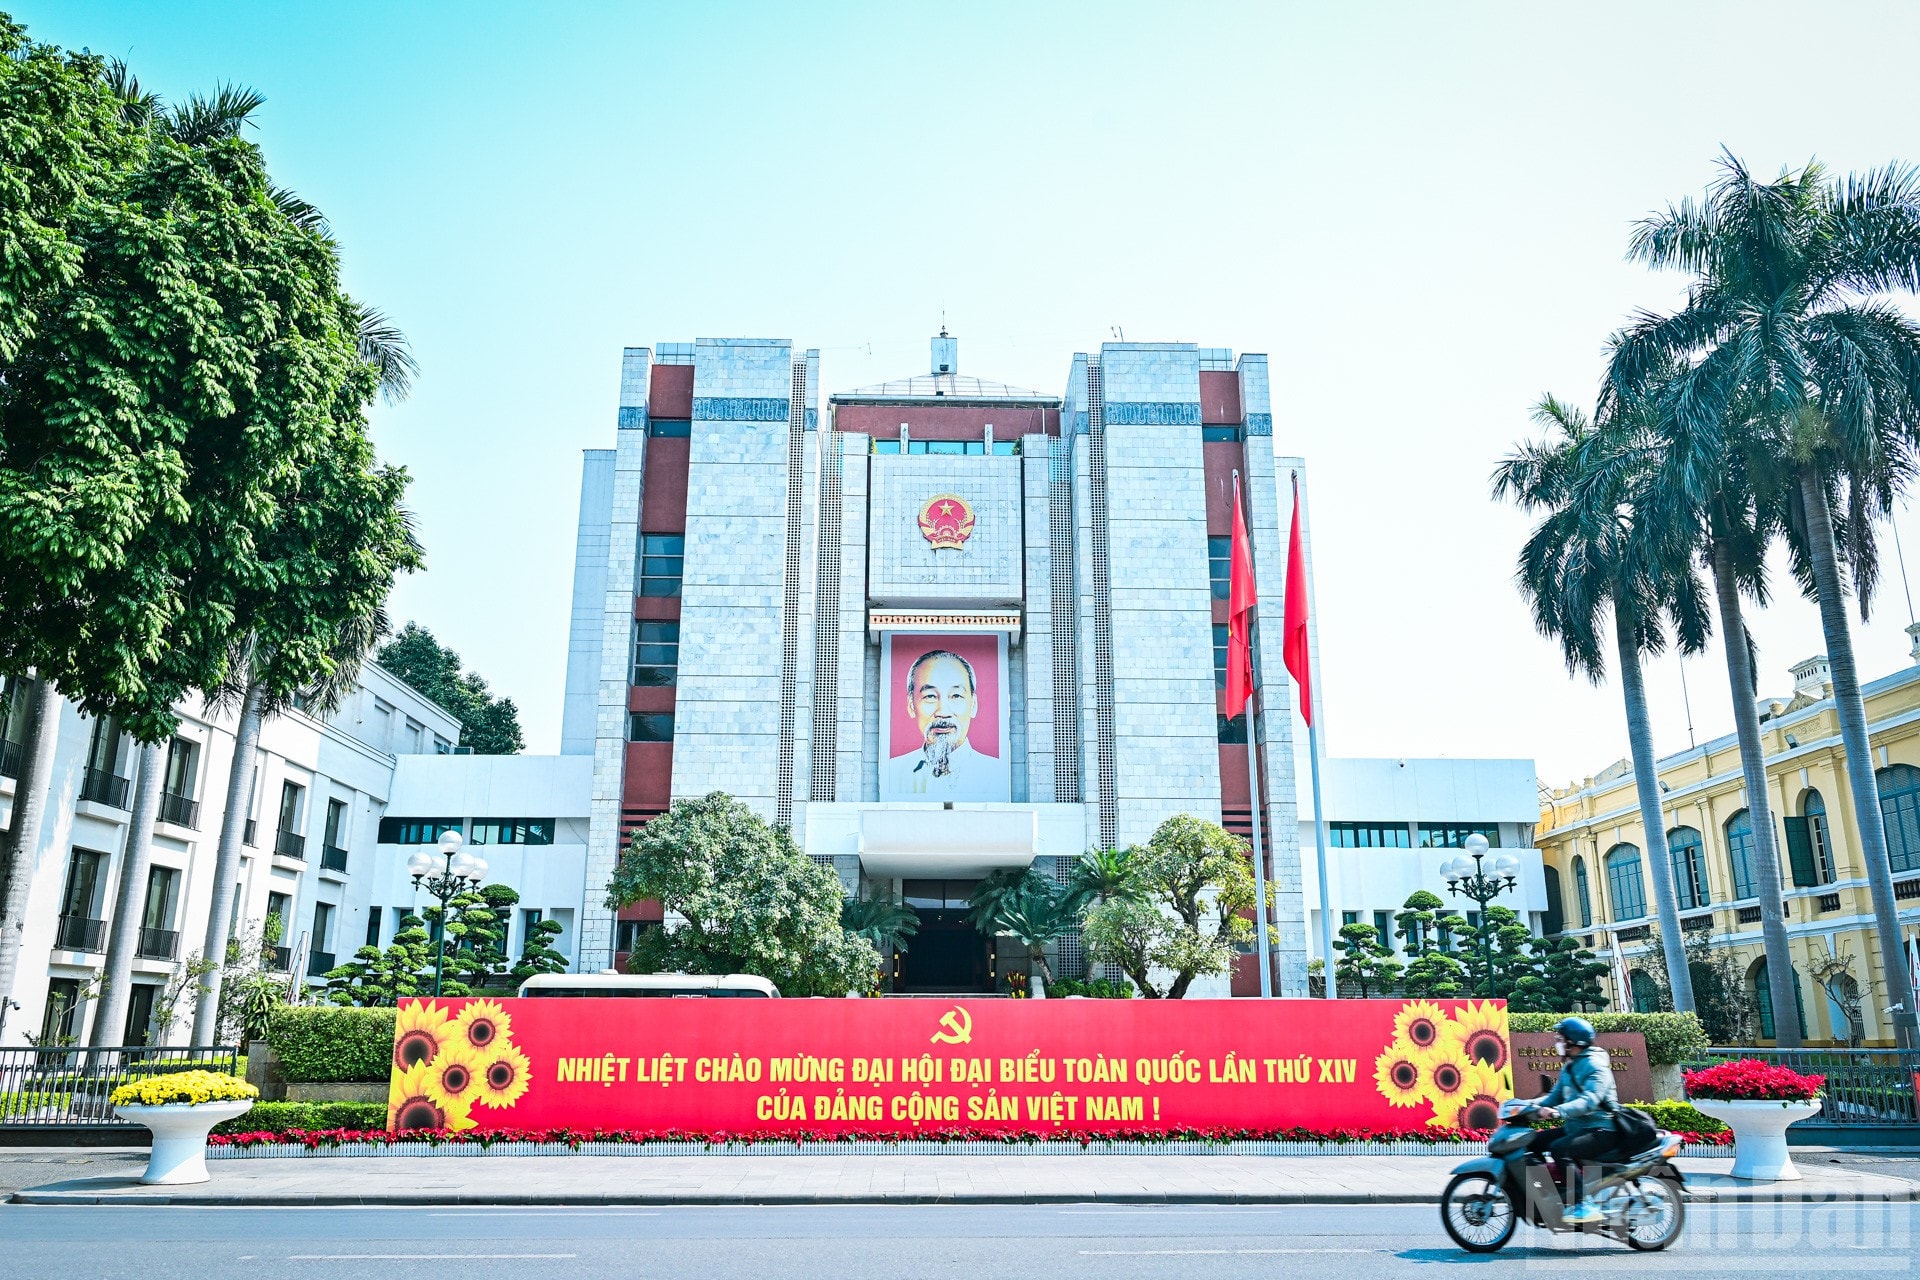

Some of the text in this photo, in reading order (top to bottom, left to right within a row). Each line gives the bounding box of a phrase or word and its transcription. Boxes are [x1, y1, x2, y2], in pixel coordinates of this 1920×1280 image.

[557, 1048, 1357, 1088] NHIỆT LIỆT CHÀO MỪNG ĐẠI HỘI ĐẠI BIỂU TOÀN QUỐC LẦN THỨ XIV
[756, 1087, 1160, 1126] CỦA ĐẢNG CỘNG SẢN VIỆT NAM !
